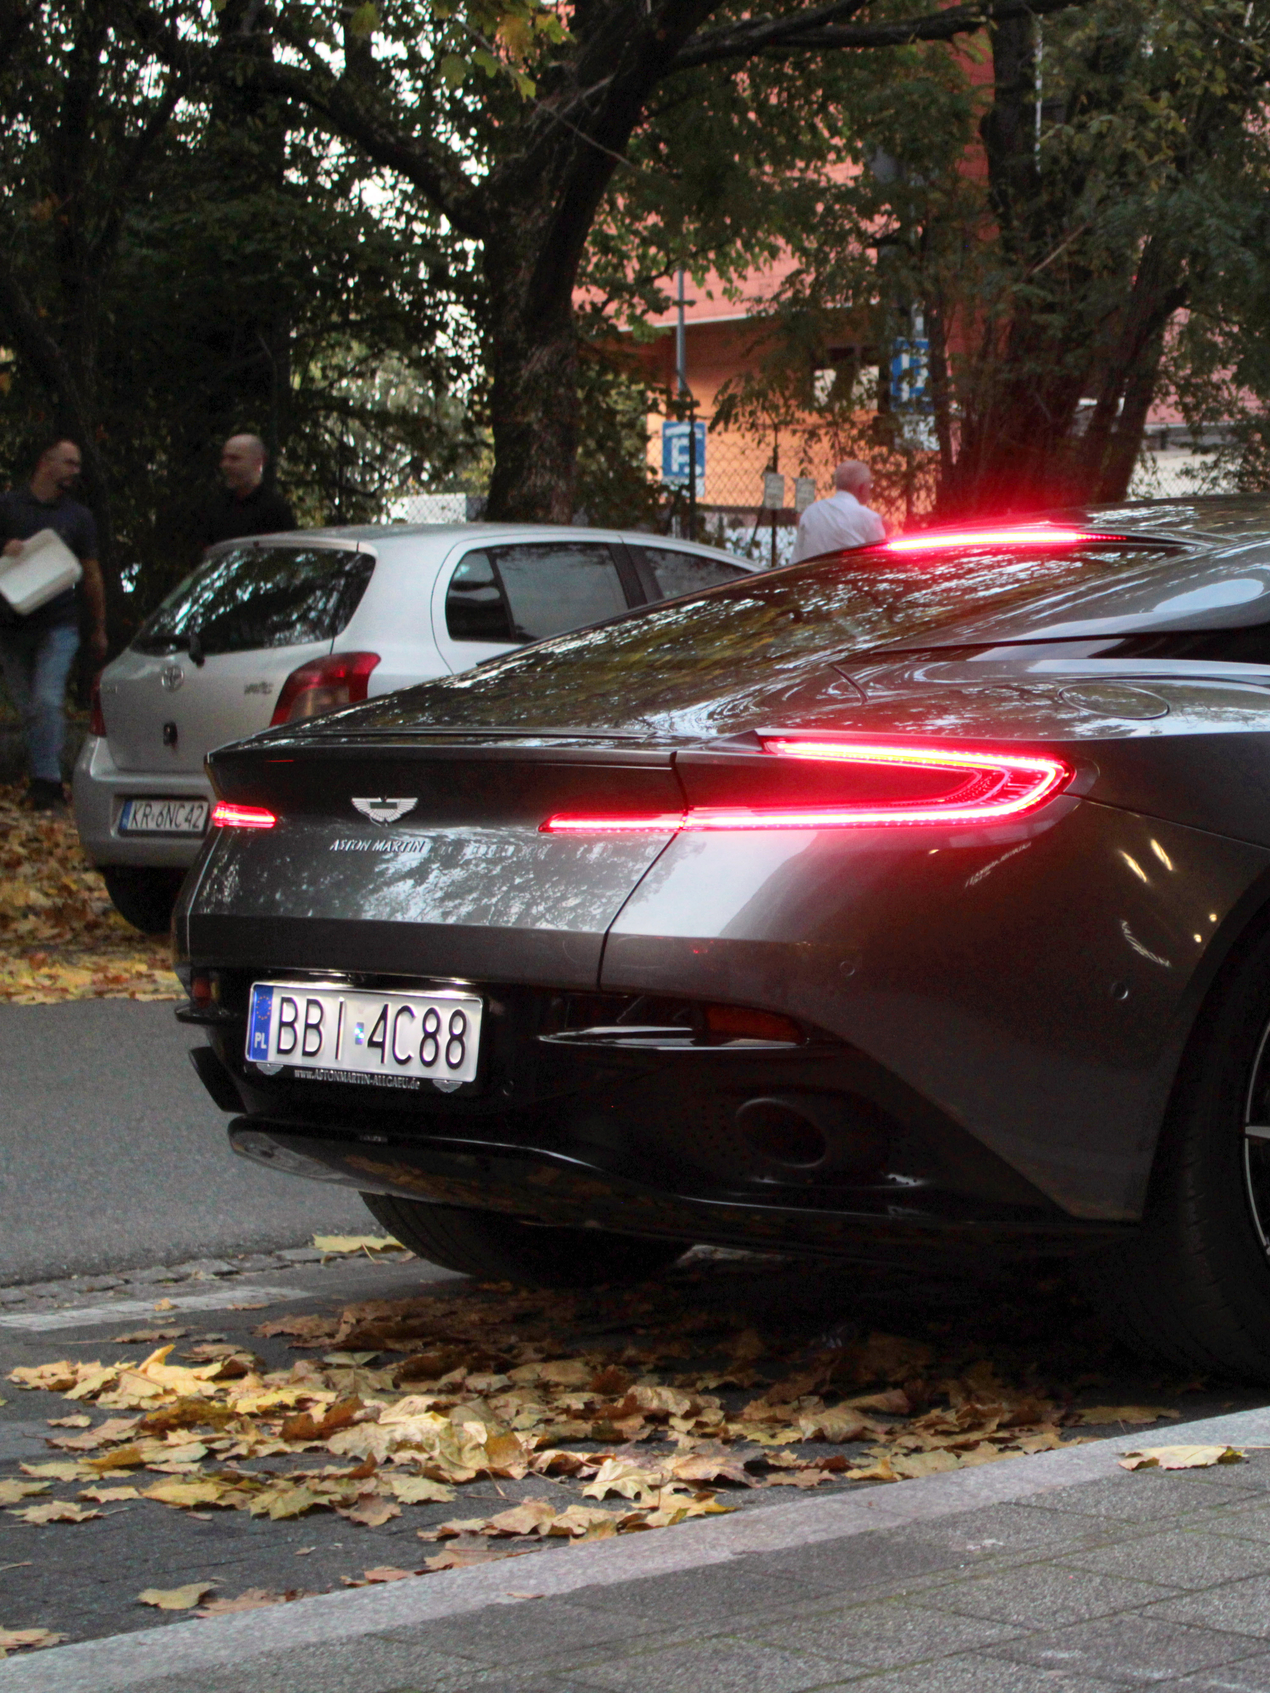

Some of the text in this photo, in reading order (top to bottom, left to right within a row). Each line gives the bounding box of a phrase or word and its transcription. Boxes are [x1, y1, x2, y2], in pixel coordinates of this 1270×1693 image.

[131, 803, 152, 828] KR
[155, 803, 204, 829] 6NC42
[329, 839, 426, 853] ASTON MARTIN
[254, 1032, 267, 1049] PL
[277, 996, 467, 1070] BBI 4C88
